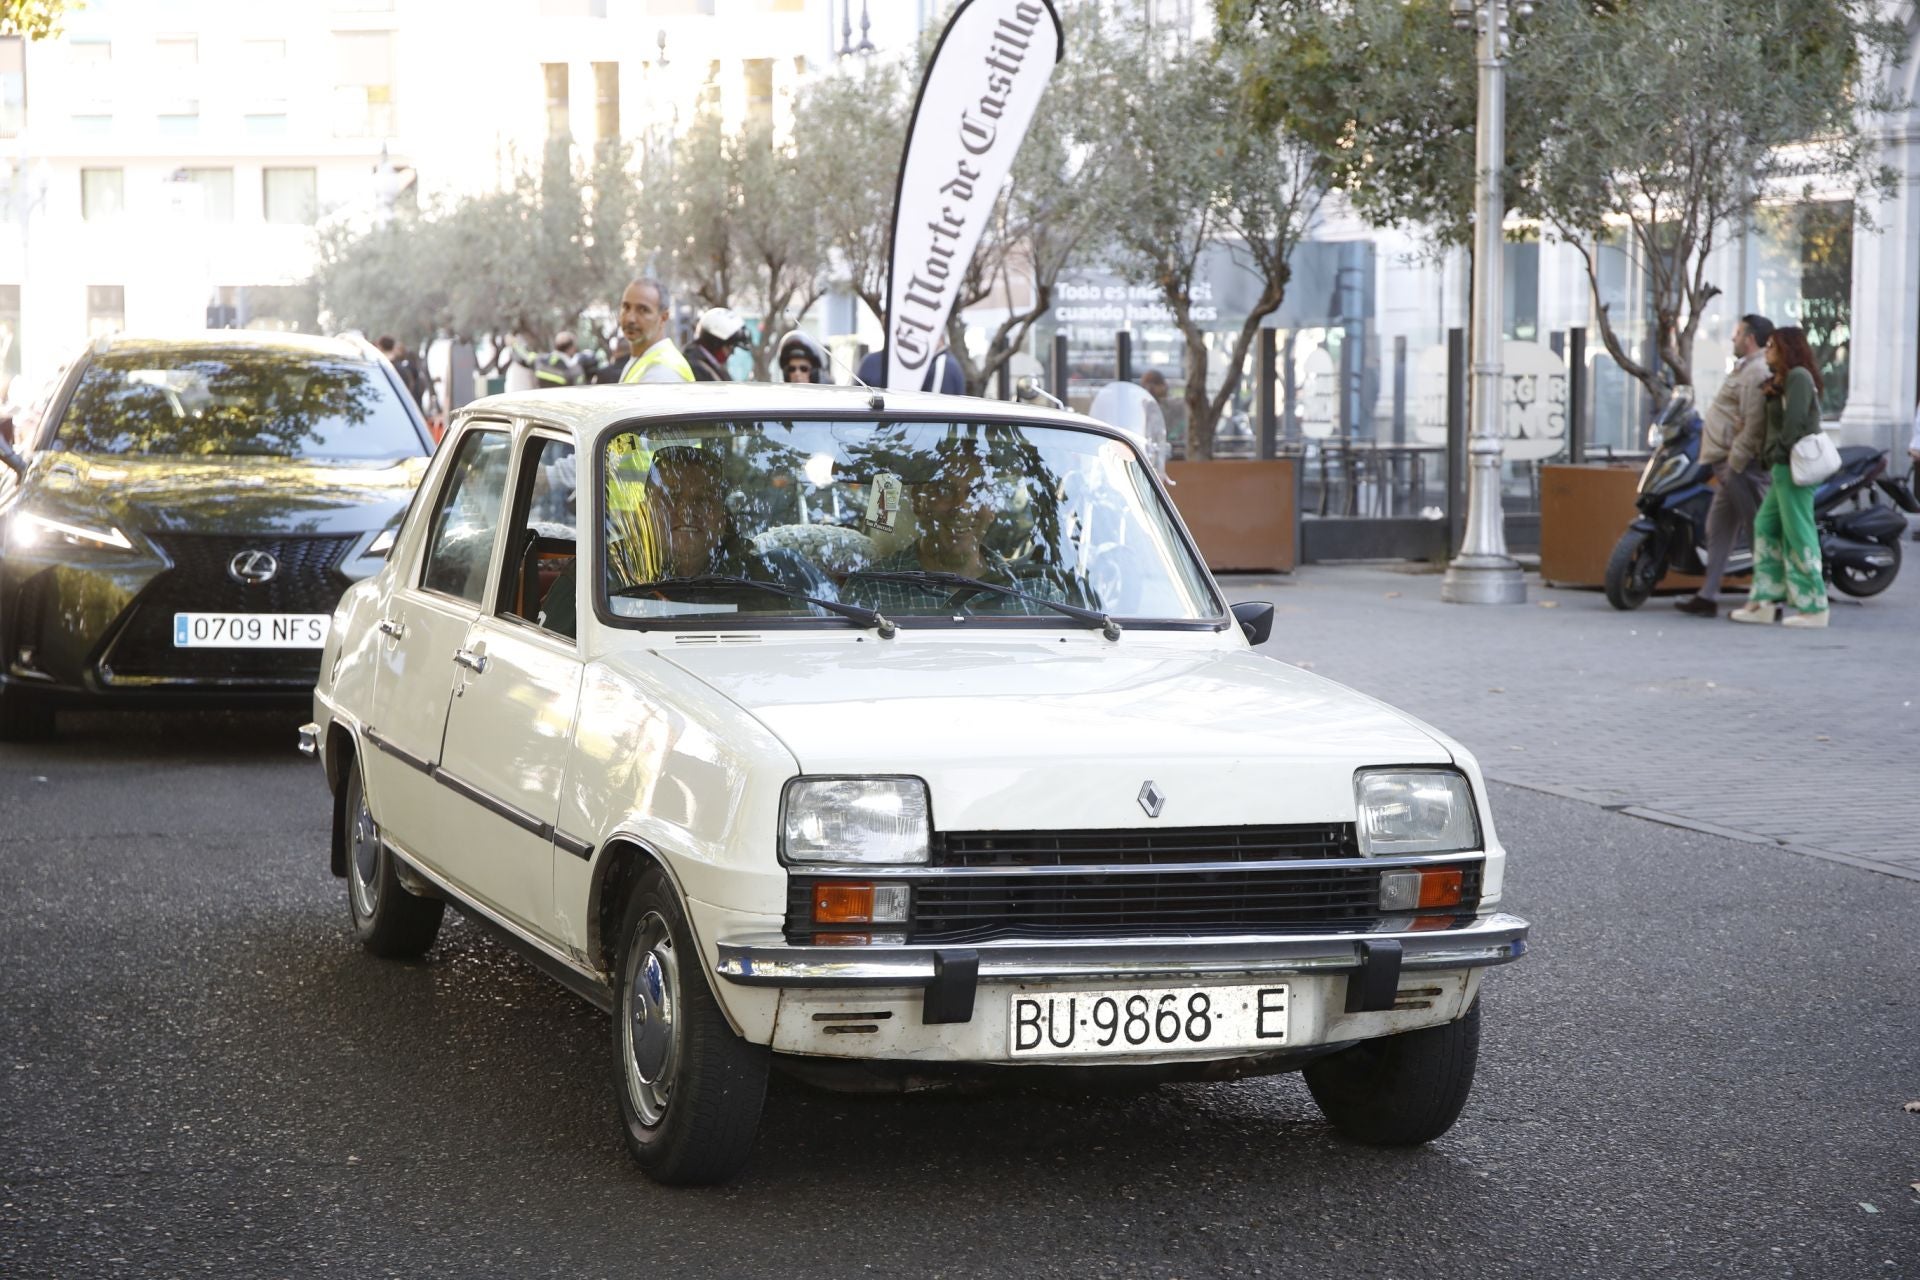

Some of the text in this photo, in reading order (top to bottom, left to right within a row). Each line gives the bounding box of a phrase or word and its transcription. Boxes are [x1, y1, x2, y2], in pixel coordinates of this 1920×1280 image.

[896, 1, 1043, 370] El Norte de Castilla
[1054, 282, 1100, 300] Todo
[1104, 286, 1126, 300] es
[1055, 303, 1124, 321] cuando
[1502, 402, 1566, 439] ING
[194, 617, 322, 641] 0709 NFS
